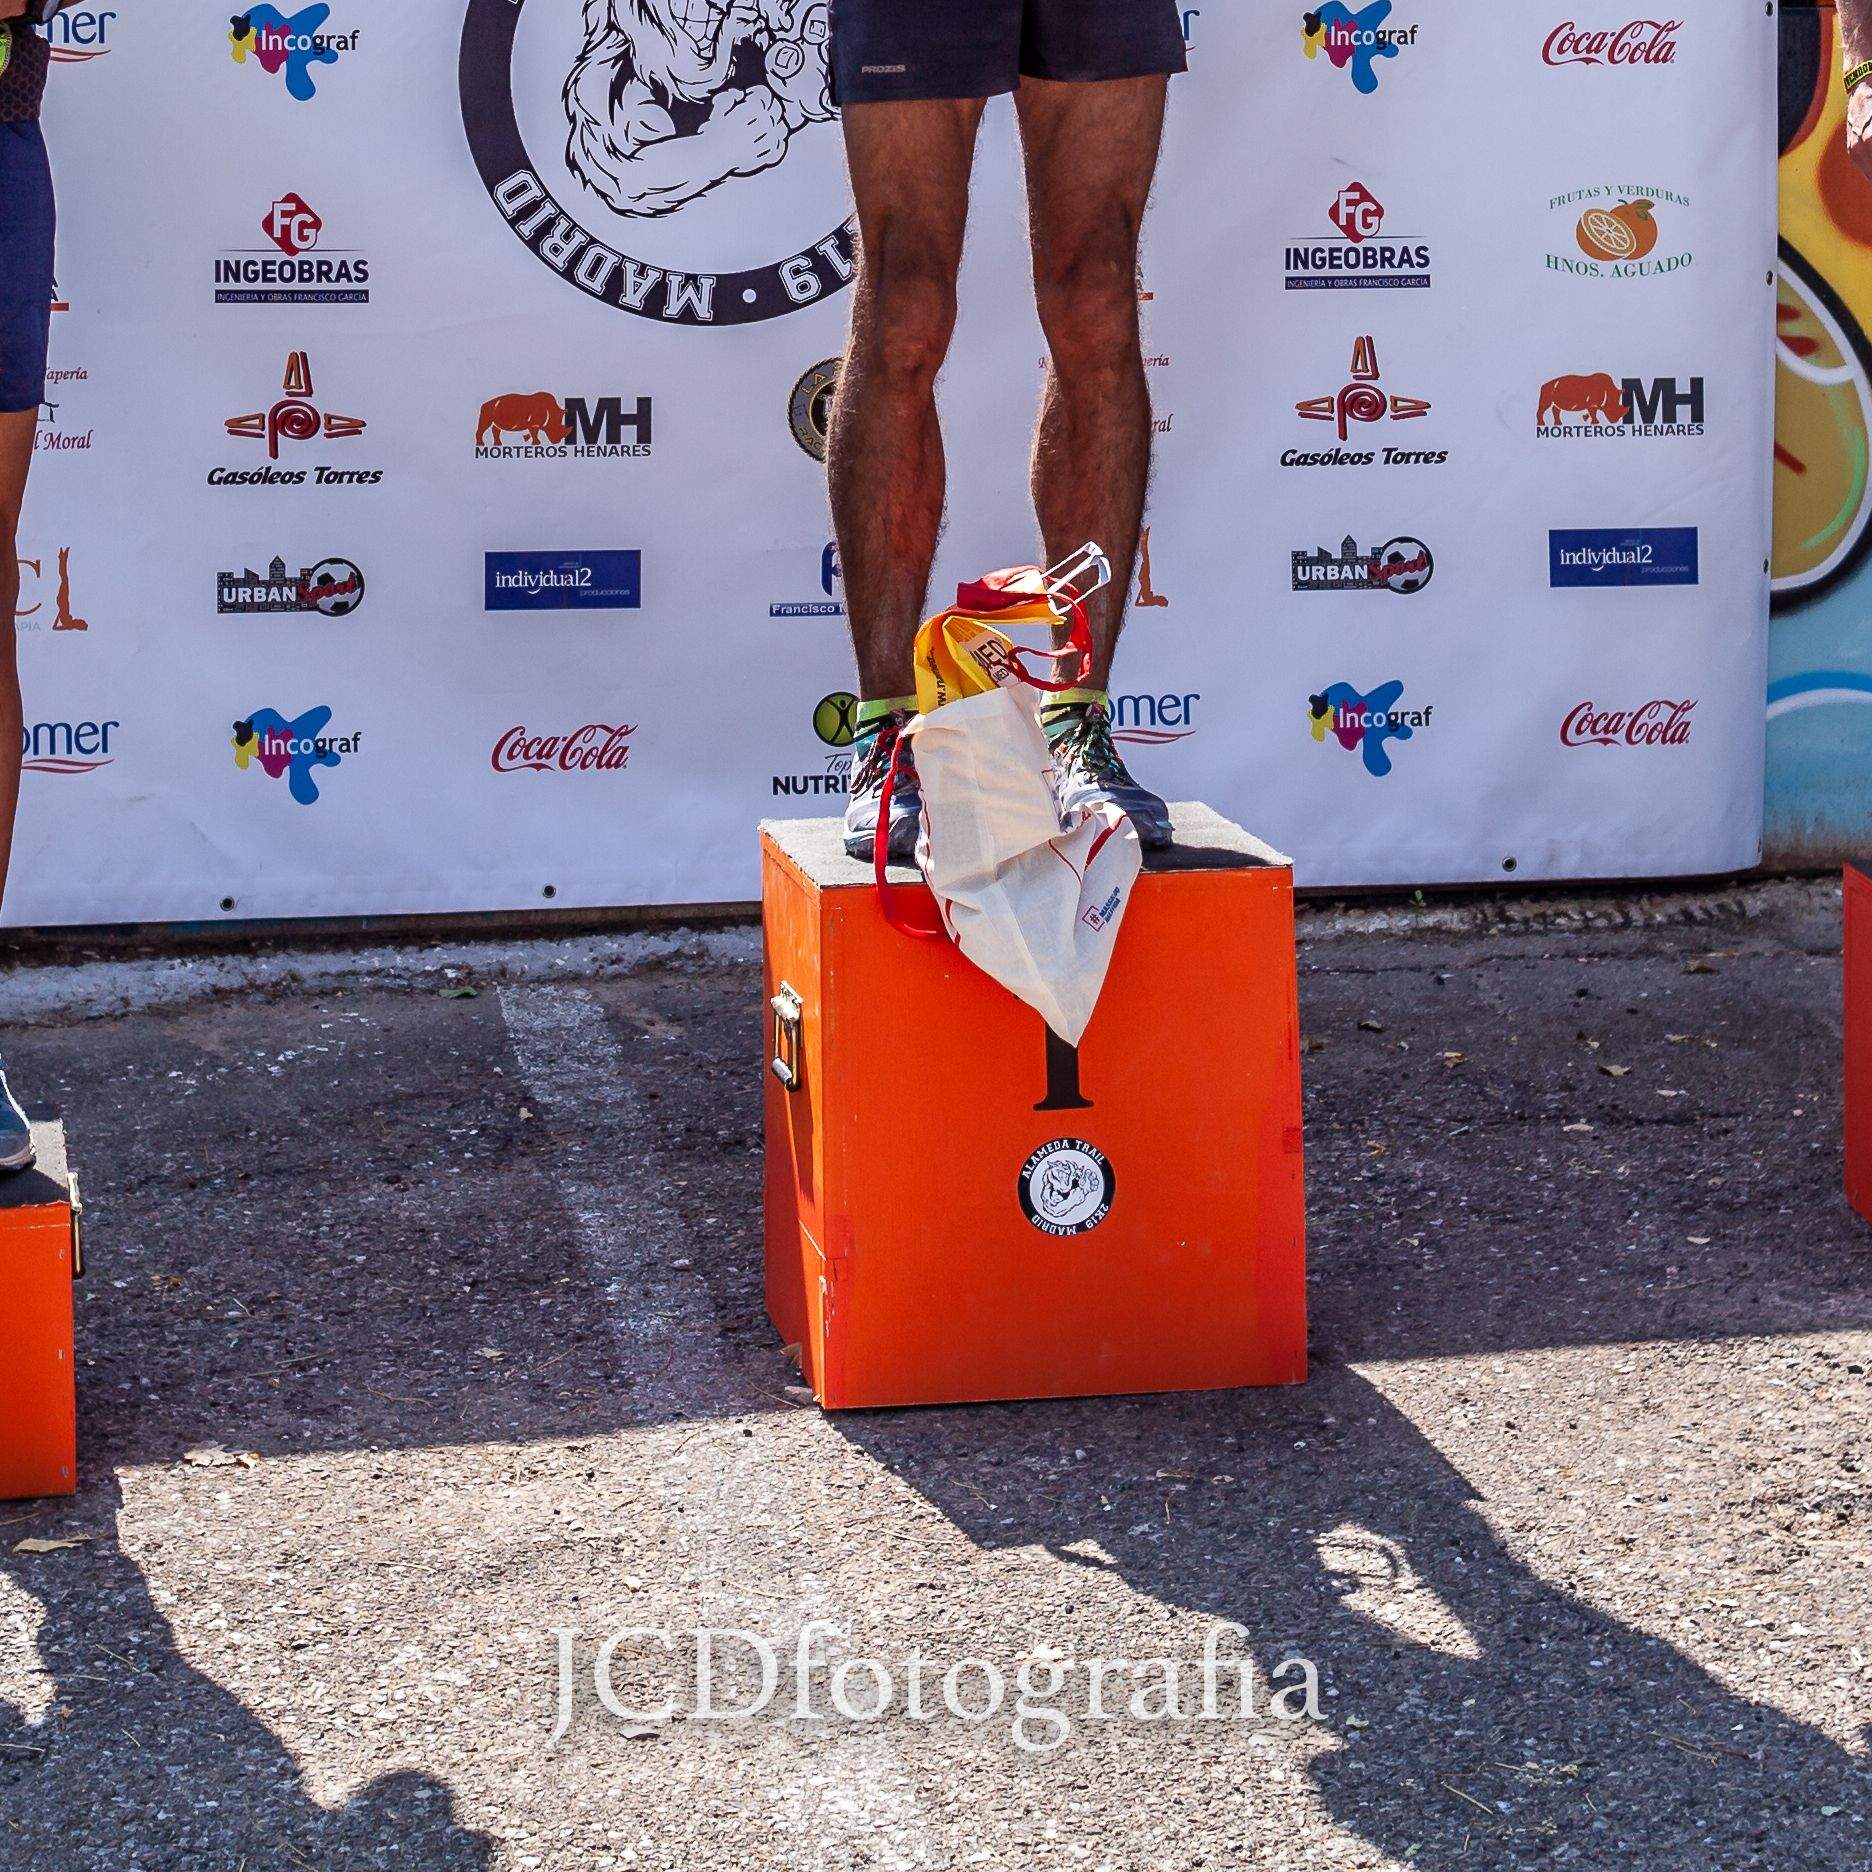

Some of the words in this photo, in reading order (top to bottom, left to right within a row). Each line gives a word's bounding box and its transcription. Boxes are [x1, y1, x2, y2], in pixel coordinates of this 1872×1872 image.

[260, 29, 360, 56] Incograf
[1329, 24, 1419, 50] Incograf
[1541, 19, 1685, 66] Coca-Cola
[1548, 188, 1602, 211] FRUTAS
[1603, 185, 1614, 197] Y
[1615, 184, 1691, 208] VERDURAS
[492, 168, 718, 323] MADRID
[1285, 245, 1431, 271] INGEOBRAS
[214, 259, 370, 285] INGEOBRAS
[1544, 252, 1606, 279] HNOS.
[1609, 251, 1694, 280] AGUADO
[293, 293, 337, 302] FRANCISCO
[1620, 376, 1705, 425] MH
[564, 396, 653, 446] MH
[1536, 425, 1627, 439] MORTEROS
[1630, 423, 1705, 438] HENARES
[43, 429, 94, 451] Moral
[474, 445, 569, 459] MORTEROS
[573, 444, 652, 459] HENARES
[1280, 447, 1375, 468] Gasóleos
[1381, 447, 1448, 466] Torres
[207, 465, 306, 486] Gasóleos
[314, 466, 383, 486] Torres
[1560, 544, 1653, 567] individual2
[495, 567, 592, 590] individual2
[1296, 564, 1369, 582] URBAN
[222, 587, 298, 605] URBAN
[772, 603, 835, 615] Francisco
[1338, 704, 1434, 733] Incograf
[1559, 698, 1700, 747] Coca-Cola
[263, 730, 362, 758] Incograf
[491, 723, 639, 773] Coca-Cola
[772, 774, 851, 796] NUTRI
[1021, 1139, 1070, 1179] ALAMEDA
[1075, 1139, 1105, 1165] TRAIL
[1031, 1214, 1077, 1236] MADRID
